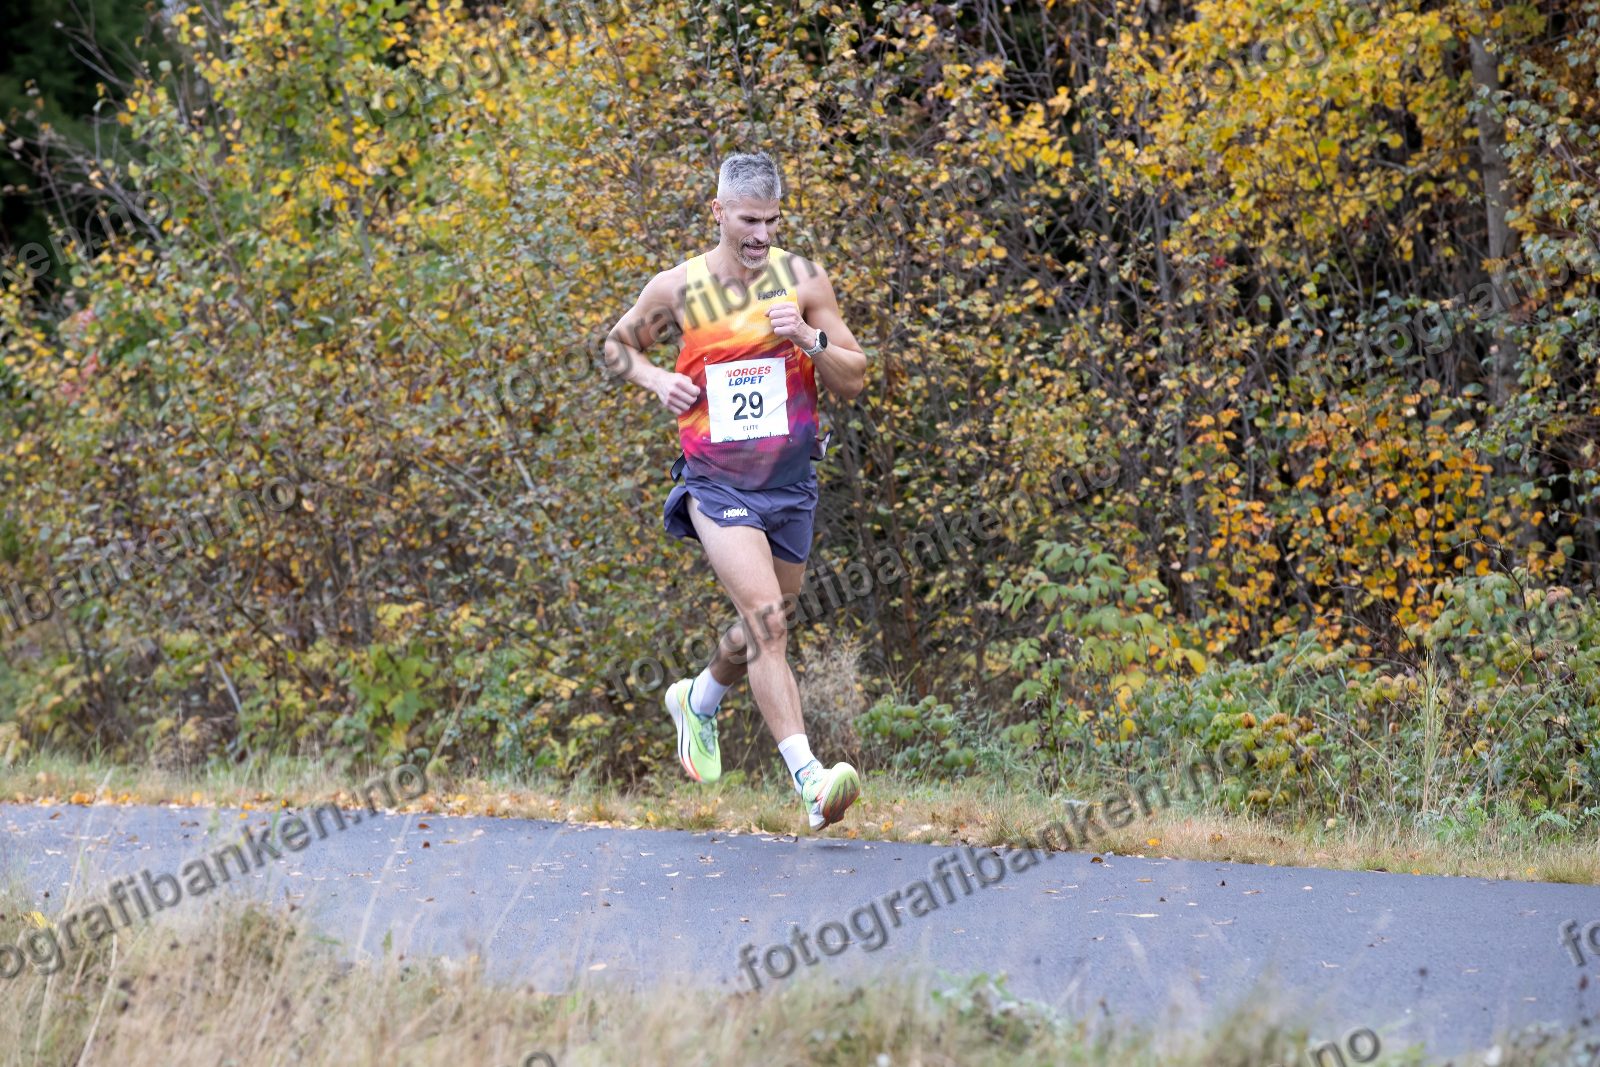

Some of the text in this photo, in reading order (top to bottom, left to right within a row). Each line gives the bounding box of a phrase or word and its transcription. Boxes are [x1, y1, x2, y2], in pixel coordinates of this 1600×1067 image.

[757, 289, 787, 300] HOKA
[725, 365, 772, 377] NORGES
[728, 375, 765, 387] LØPET
[732, 390, 764, 421] 29
[723, 508, 748, 519] HOKA
